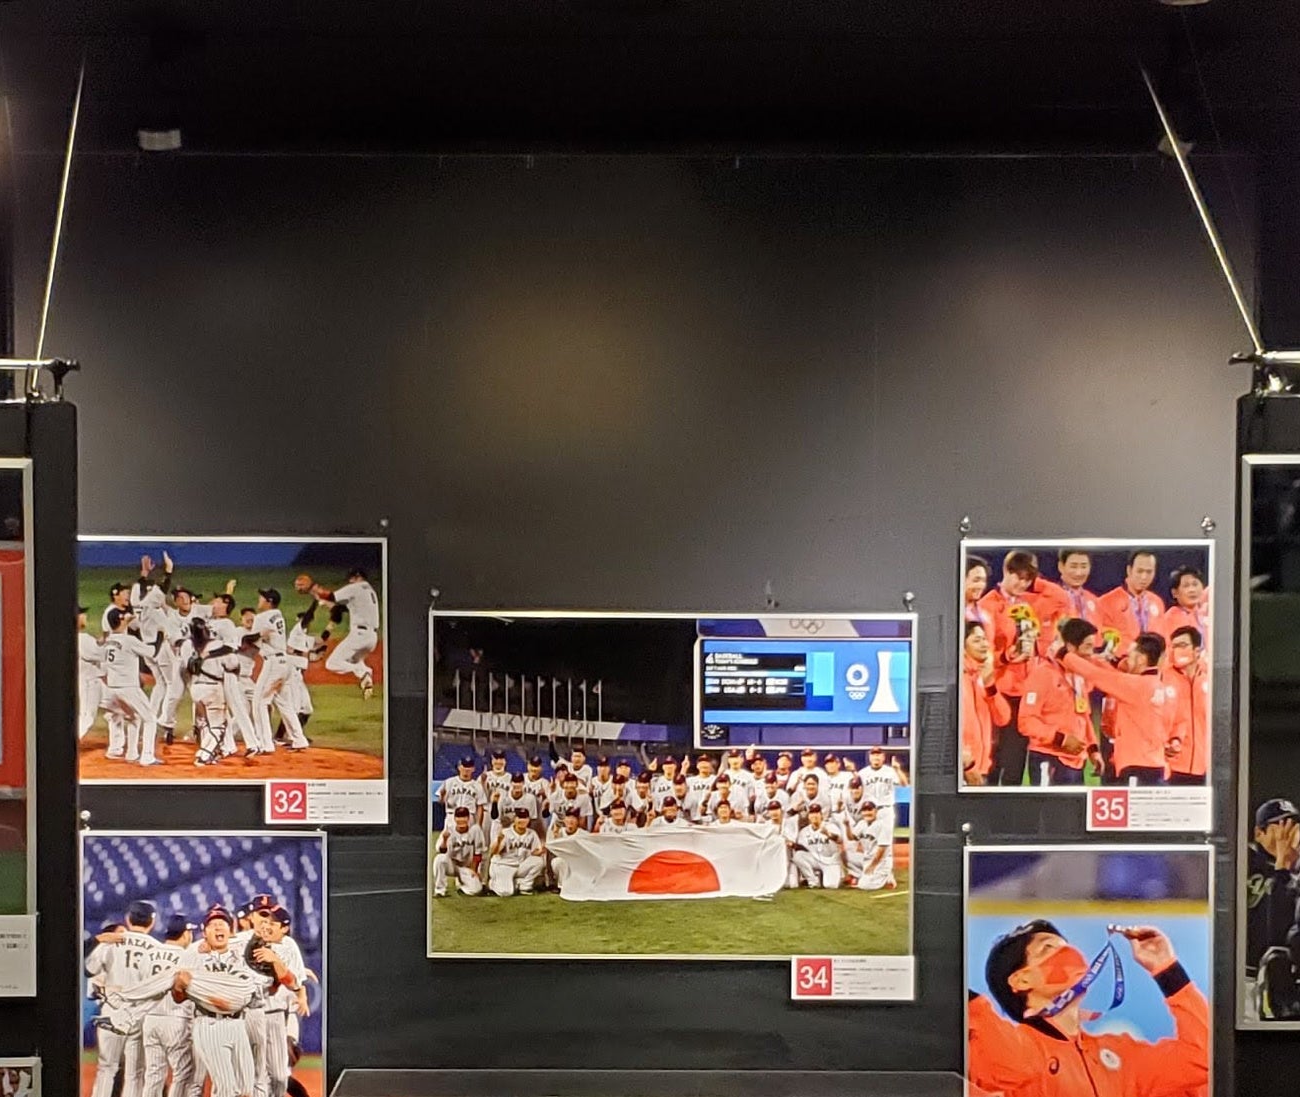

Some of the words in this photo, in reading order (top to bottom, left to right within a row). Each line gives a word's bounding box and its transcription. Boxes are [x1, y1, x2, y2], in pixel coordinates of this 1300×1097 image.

[478, 713, 543, 736] TOKYO
[274, 790, 302, 814] 32
[1095, 797, 1125, 820] 35
[800, 965, 828, 989] 34
